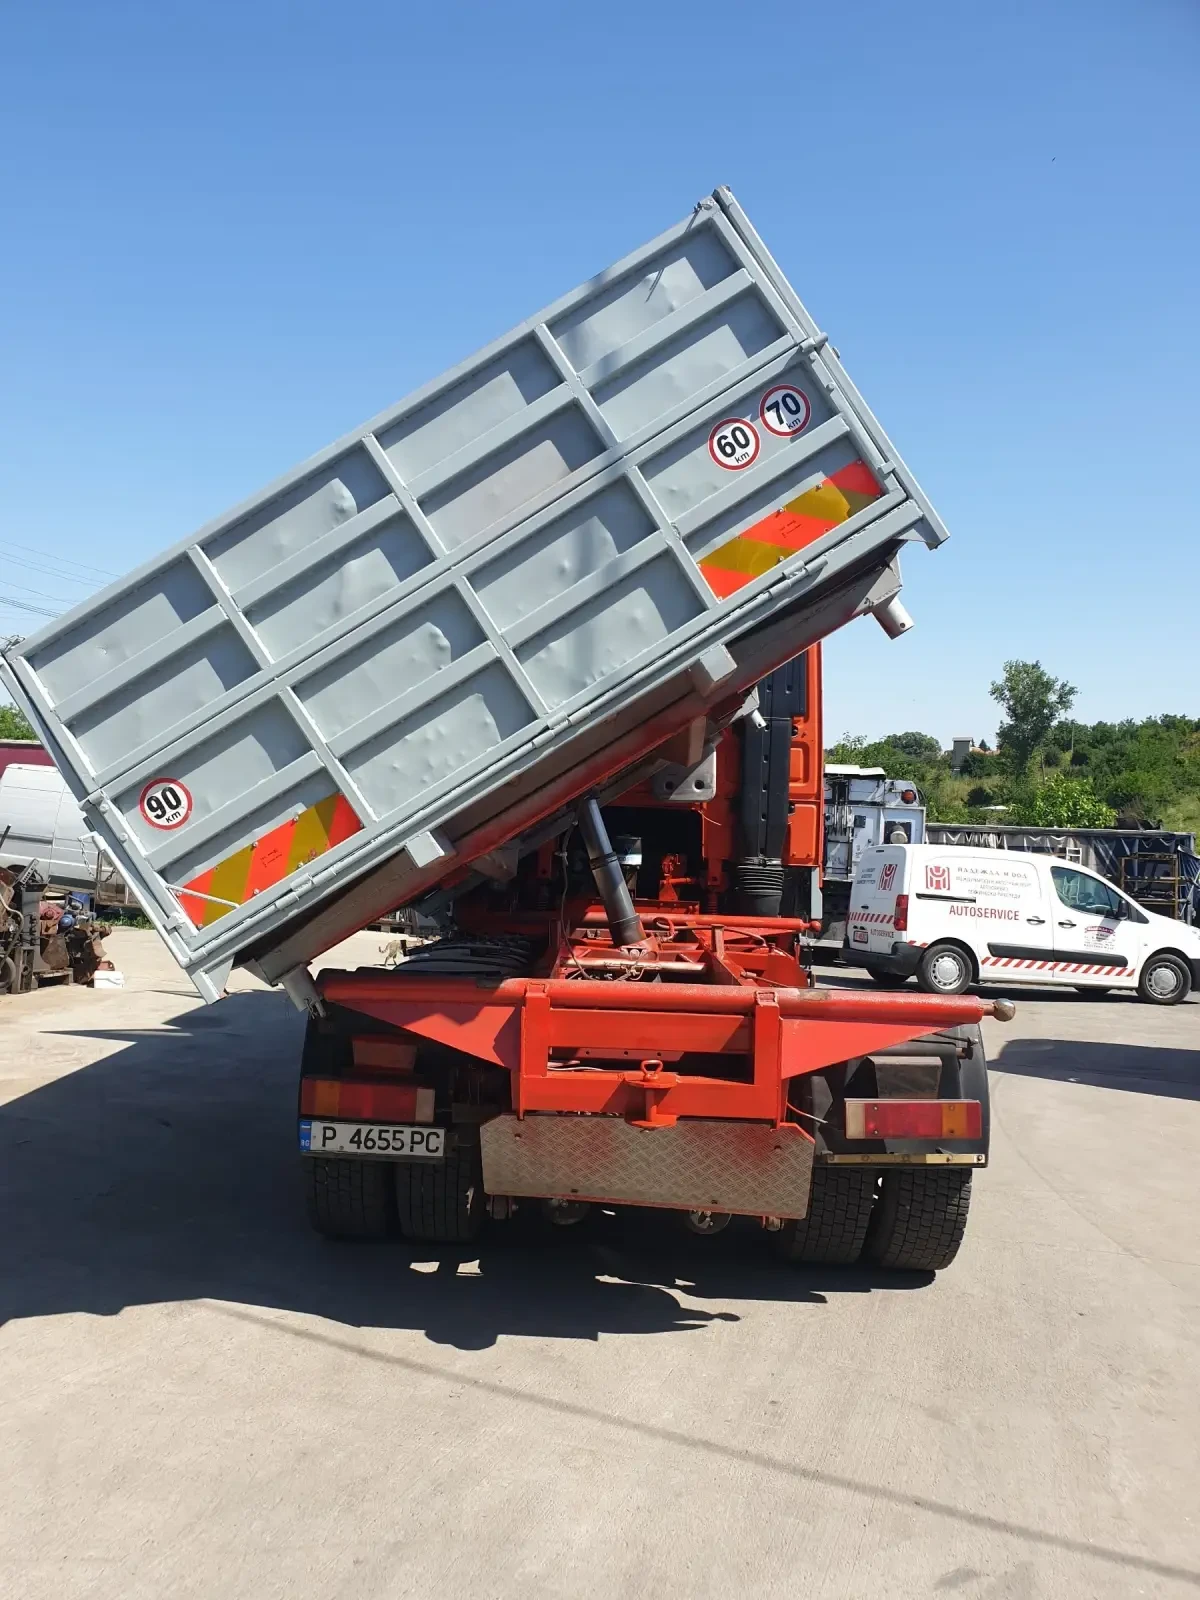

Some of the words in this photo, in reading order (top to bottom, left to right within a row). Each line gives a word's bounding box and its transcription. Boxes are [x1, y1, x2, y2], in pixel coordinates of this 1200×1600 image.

[765, 392, 801, 426] 70
[786, 418, 801, 429] km
[716, 426, 750, 458] 60
[734, 452, 750, 464] km
[146, 786, 182, 820] 90
[949, 904, 1020, 921] AUTOSERVICE
[321, 1126, 337, 1147] P
[348, 1128, 405, 1151] 4655
[409, 1130, 441, 1153] PC
